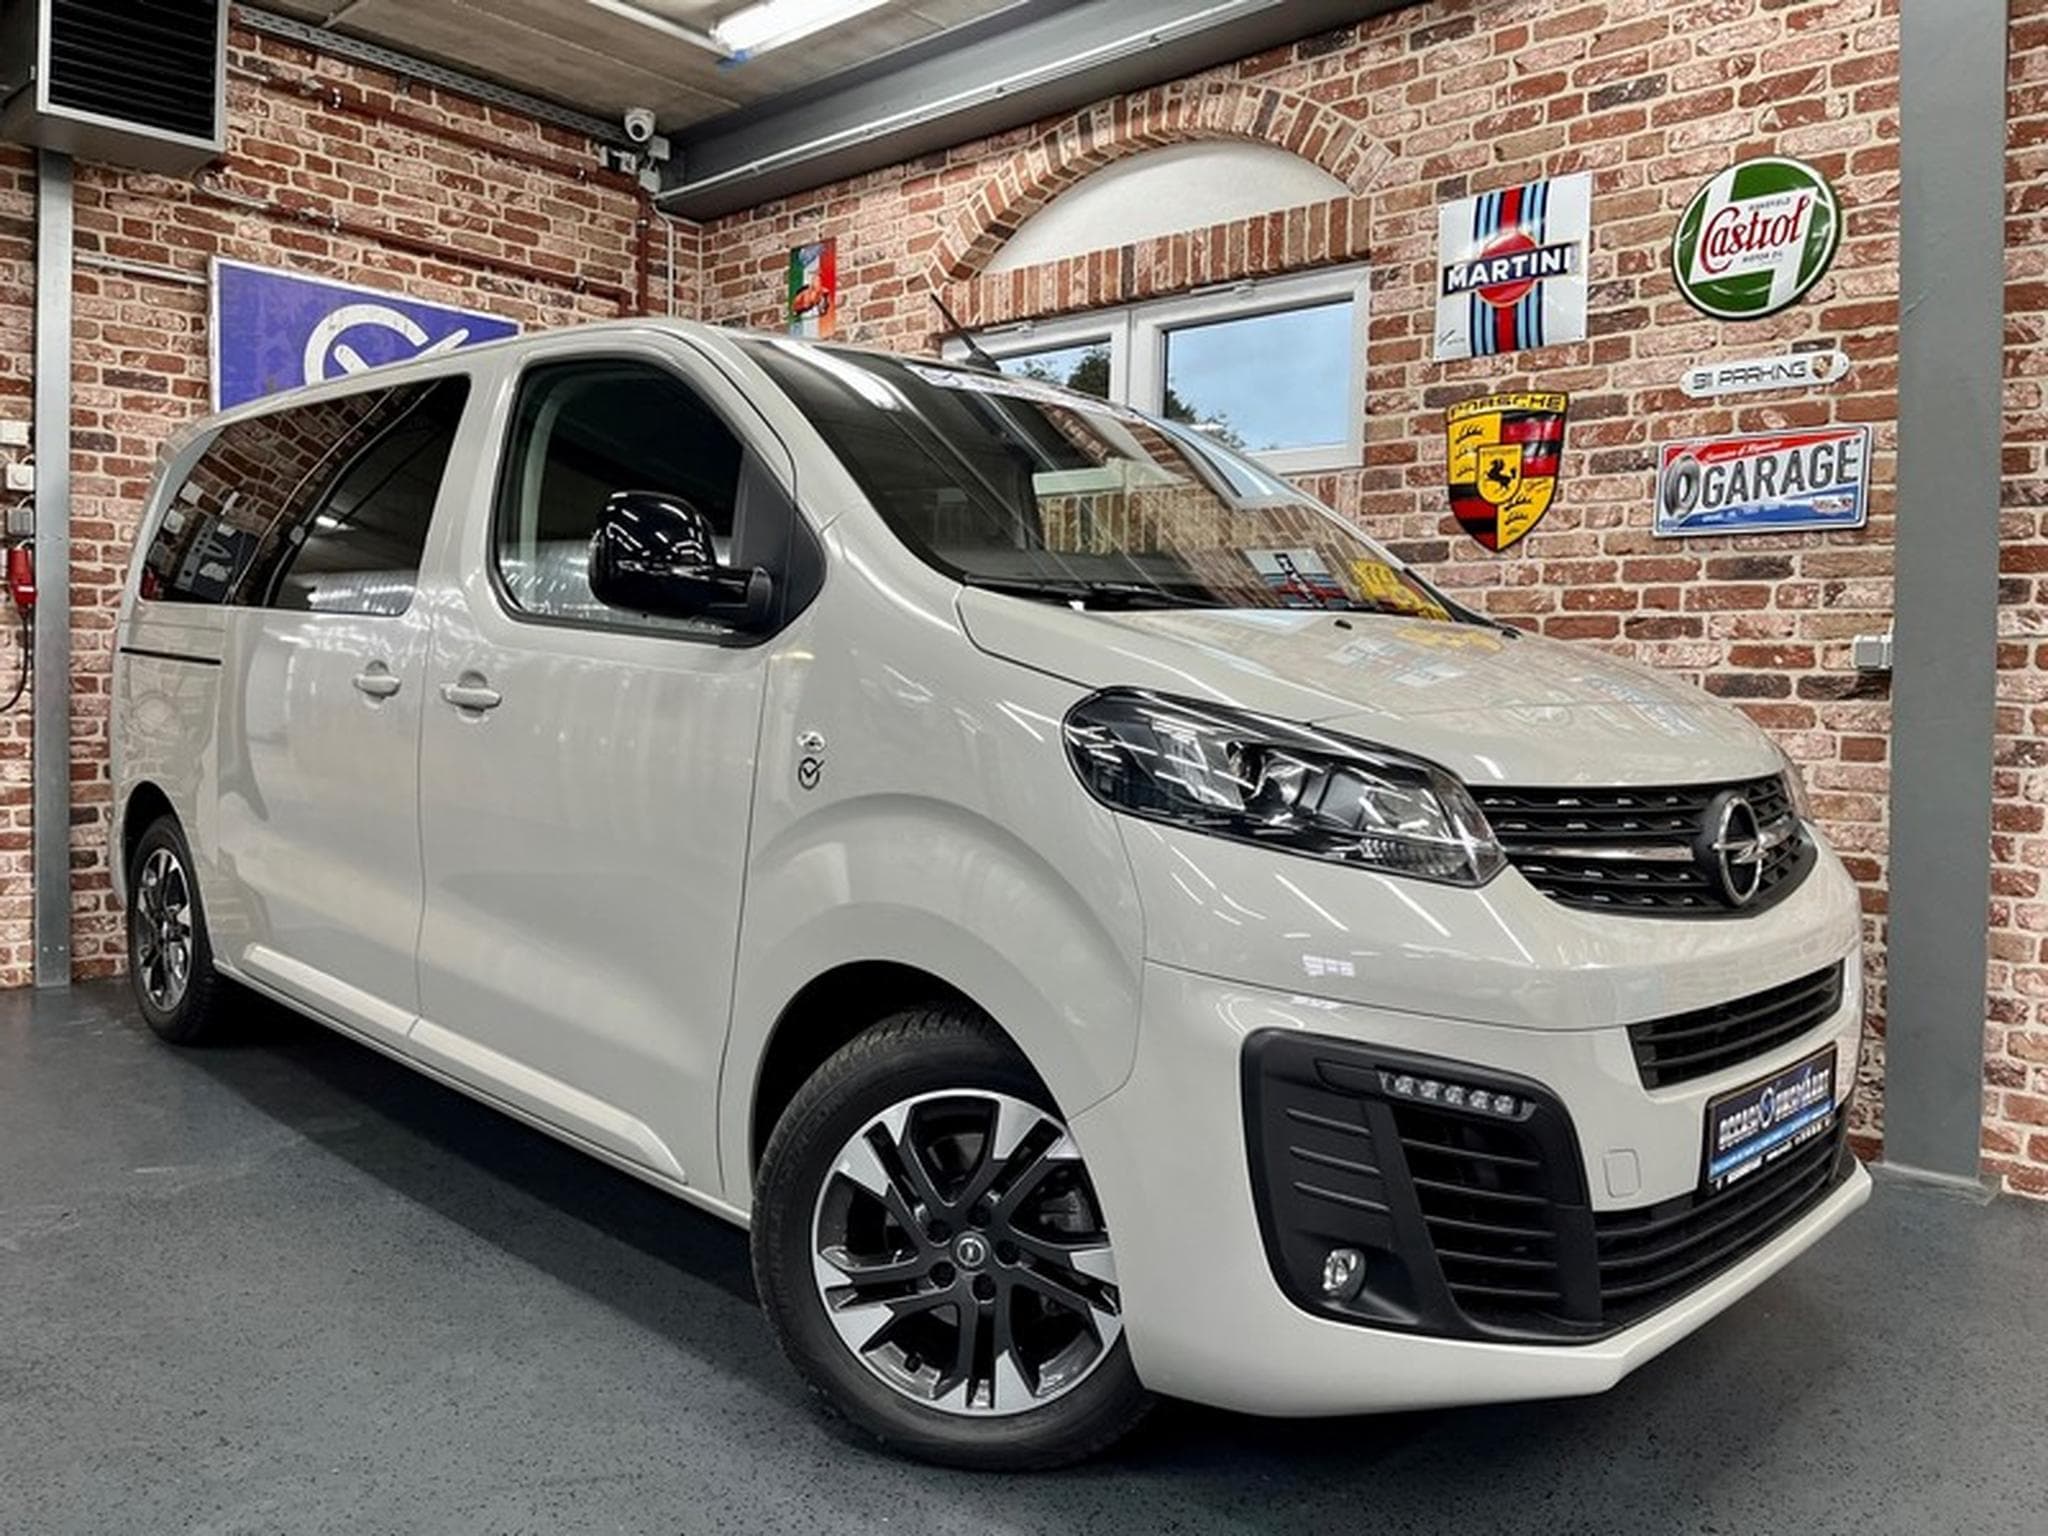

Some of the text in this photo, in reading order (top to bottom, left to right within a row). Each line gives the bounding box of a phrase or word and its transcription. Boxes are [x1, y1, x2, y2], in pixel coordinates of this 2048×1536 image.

[1701, 195, 1810, 273] Castrol
[1447, 247, 1570, 290] MARTINI
[1718, 360, 1807, 386] PARKING
[1450, 394, 1562, 418] PORSCHE
[1702, 437, 1862, 509] GARAGE
